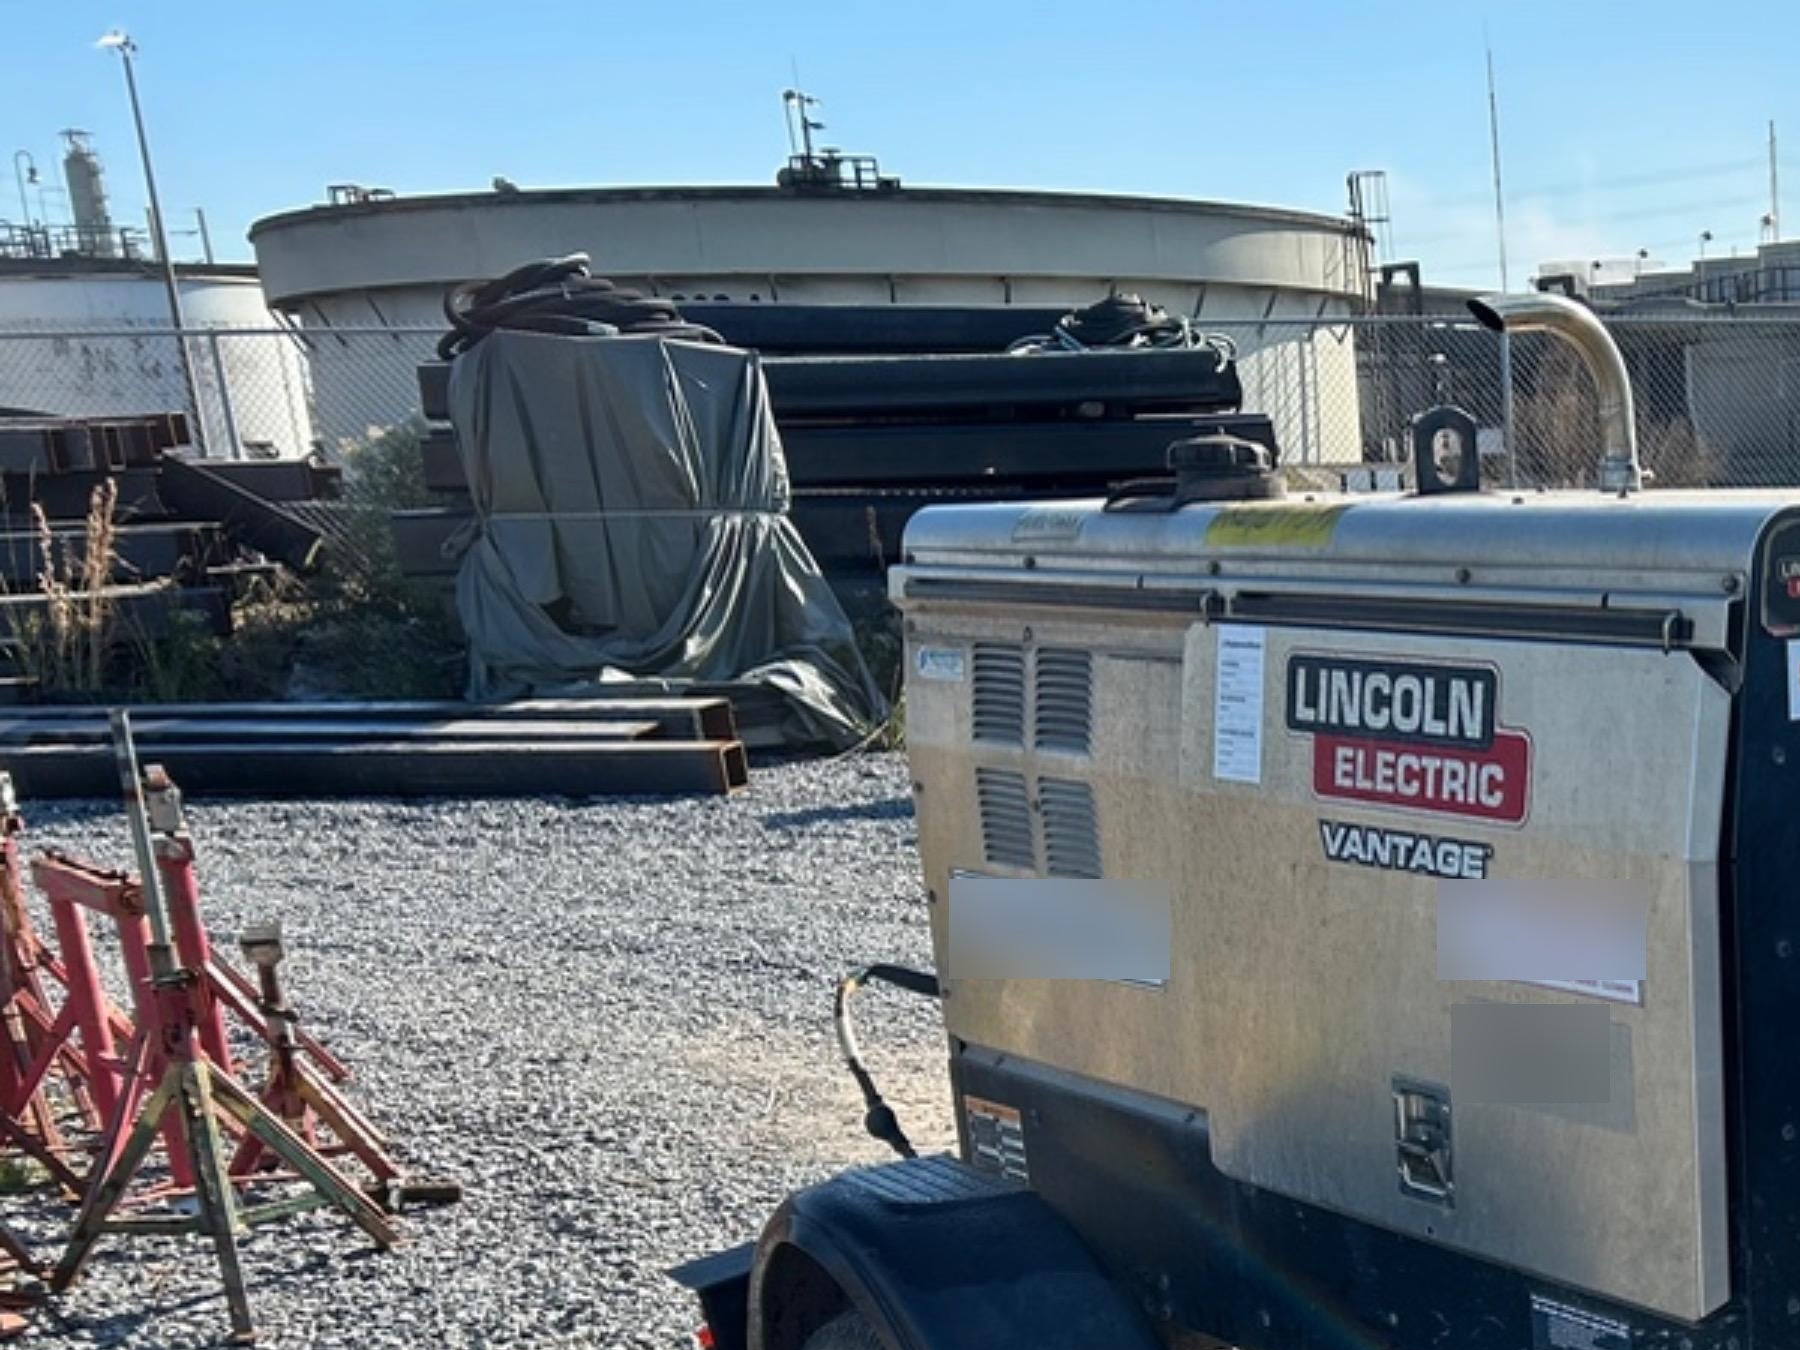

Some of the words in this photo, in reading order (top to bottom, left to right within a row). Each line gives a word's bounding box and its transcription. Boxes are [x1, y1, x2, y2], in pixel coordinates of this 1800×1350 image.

[1294, 667, 1484, 740] LINCOLN
[1333, 745, 1505, 808] ELECTRIC
[1320, 822, 1486, 880] VANTAGE
